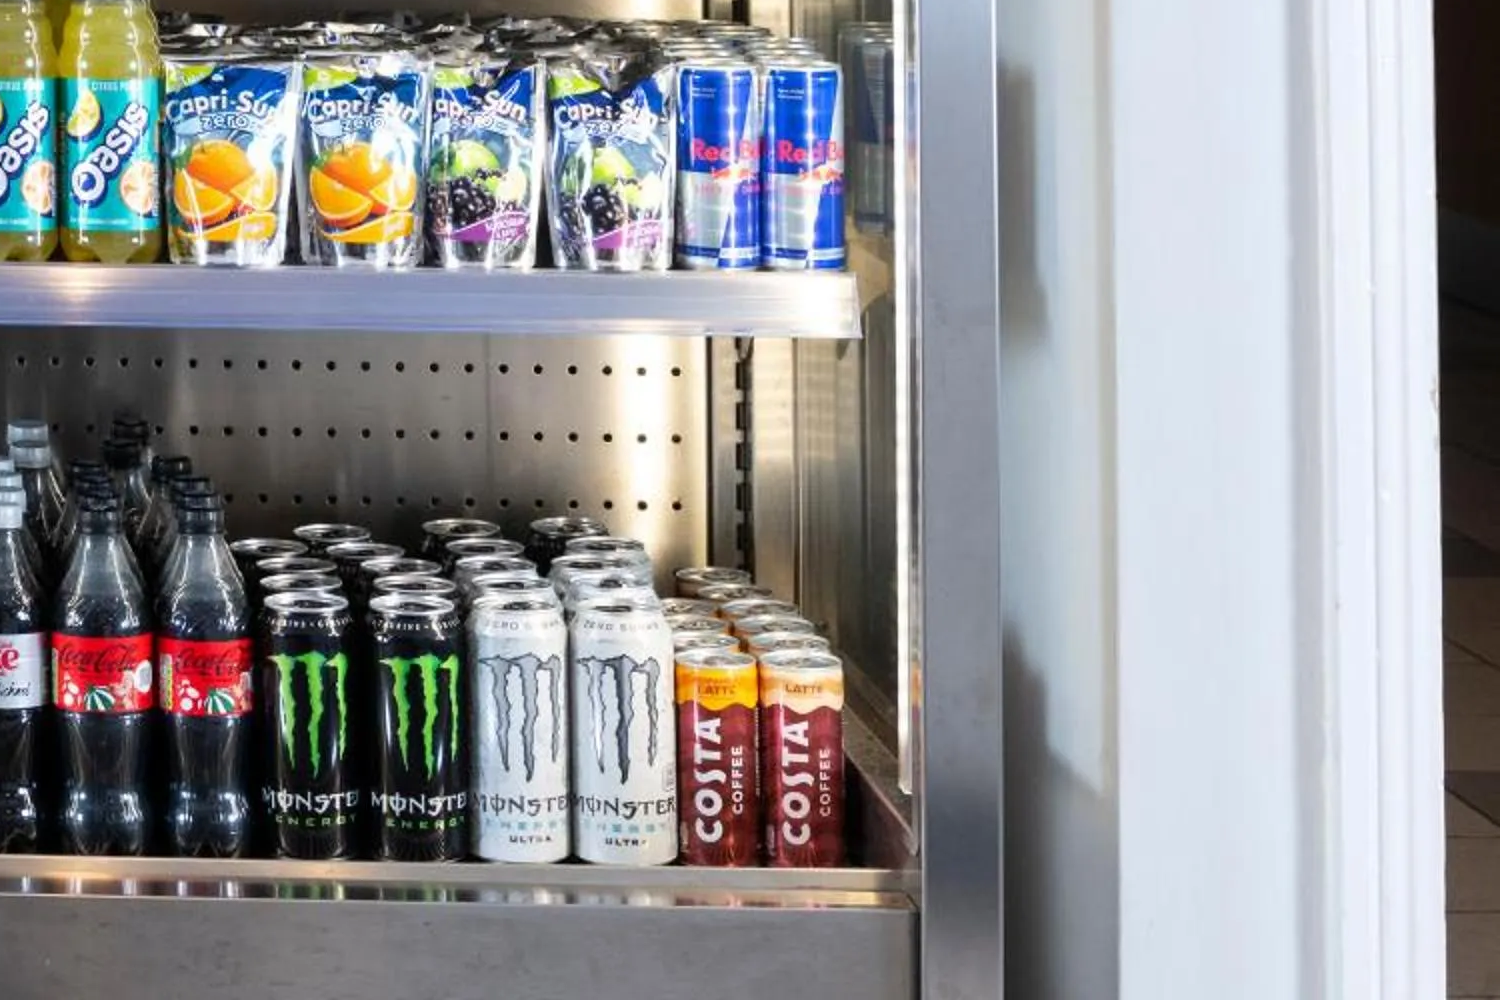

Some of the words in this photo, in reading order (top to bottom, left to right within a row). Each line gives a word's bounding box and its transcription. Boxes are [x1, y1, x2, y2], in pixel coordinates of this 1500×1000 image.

[166, 87, 280, 122] Capri-Sun
[201, 113, 251, 131] zero
[307, 90, 419, 122] Capri-Sun
[71, 101, 149, 202] Oasis
[261, 786, 360, 814] MONSTE
[371, 790, 467, 818] MONSTE
[694, 717, 727, 843] COSTA
[731, 744, 744, 815] COFFEE
[782, 720, 815, 846] COSTA
[819, 747, 831, 818] COFFEE
